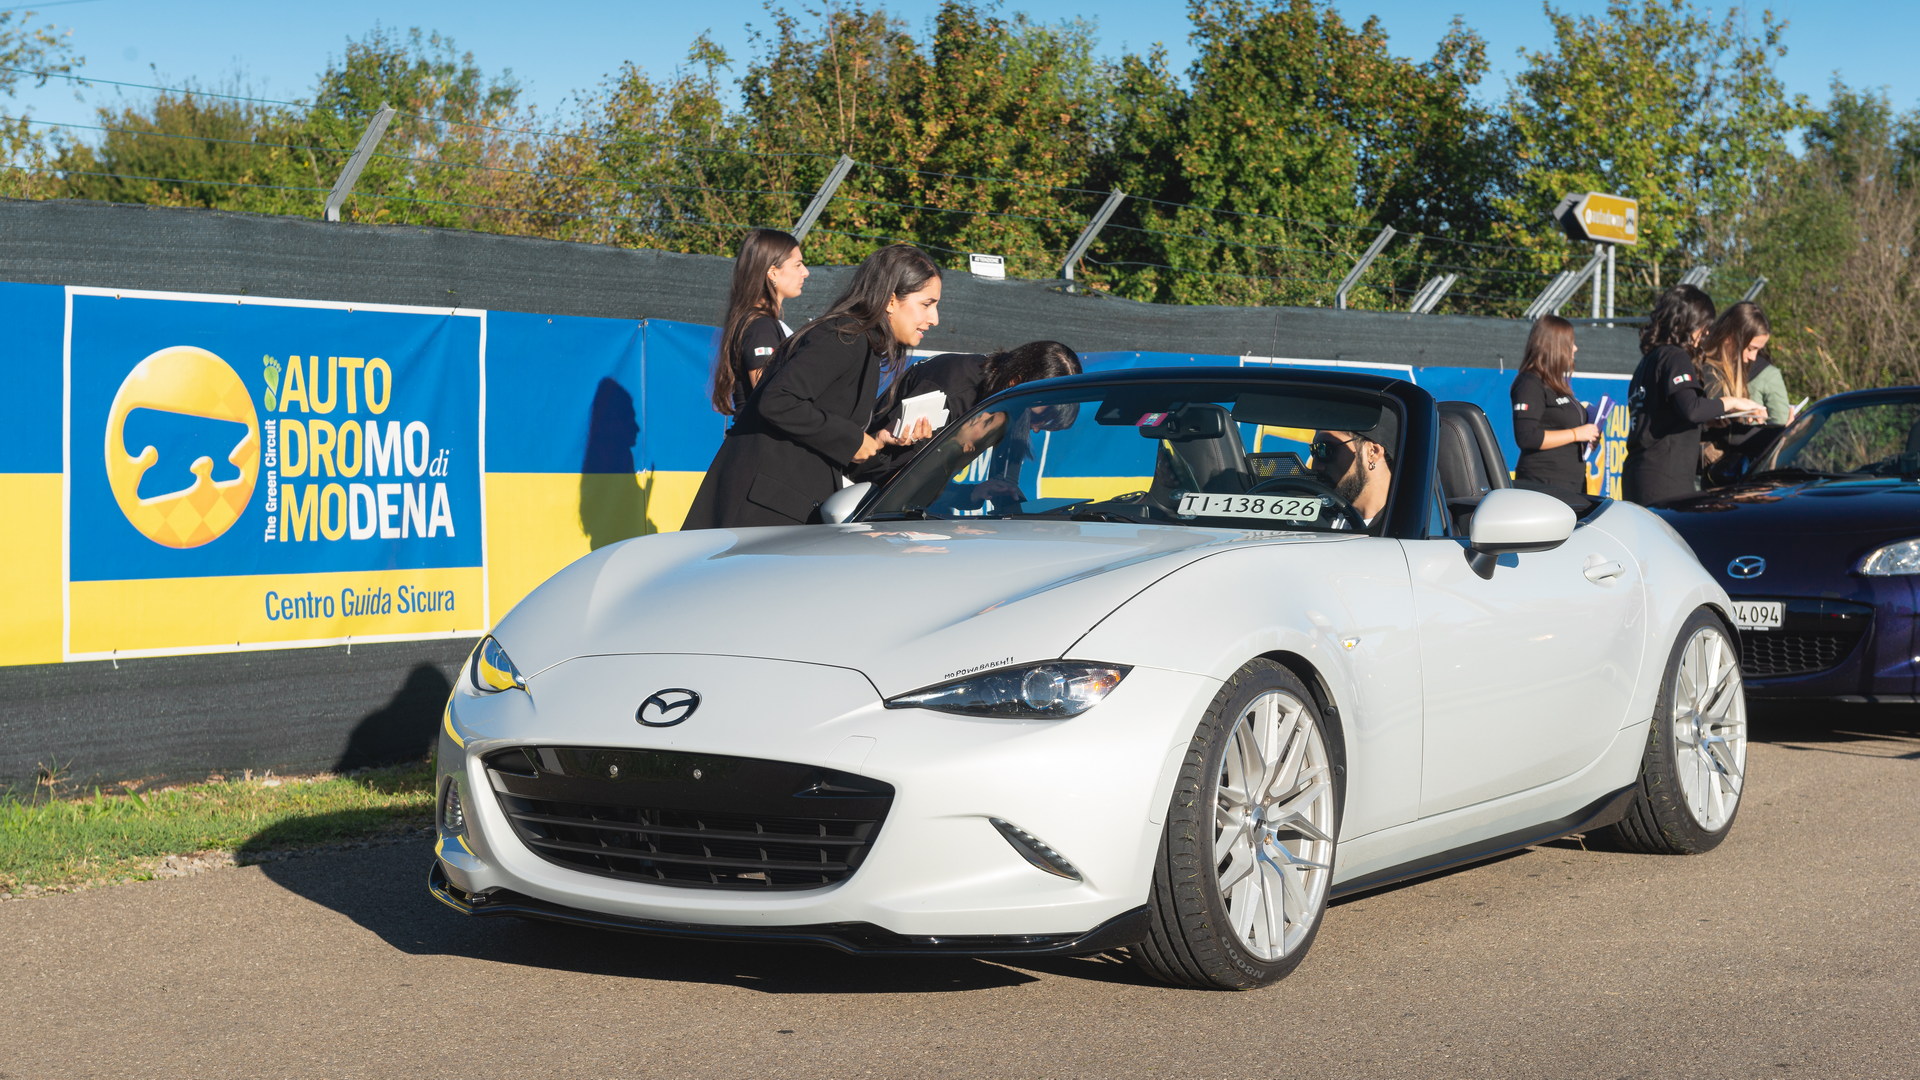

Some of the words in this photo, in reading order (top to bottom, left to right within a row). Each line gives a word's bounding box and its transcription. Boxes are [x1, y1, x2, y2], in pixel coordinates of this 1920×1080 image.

[279, 355, 392, 415] AUTO
[264, 419, 277, 468] Circuit
[279, 418, 430, 478] DROMO
[429, 448, 450, 477] di
[265, 470, 278, 513] Green
[280, 482, 456, 542] MODENA
[1270, 499, 1316, 517] 626
[264, 515, 277, 543] The
[265, 590, 335, 621] Centro
[341, 586, 392, 618] Guida
[397, 584, 455, 614] Sicura
[1750, 605, 1779, 624] 094
